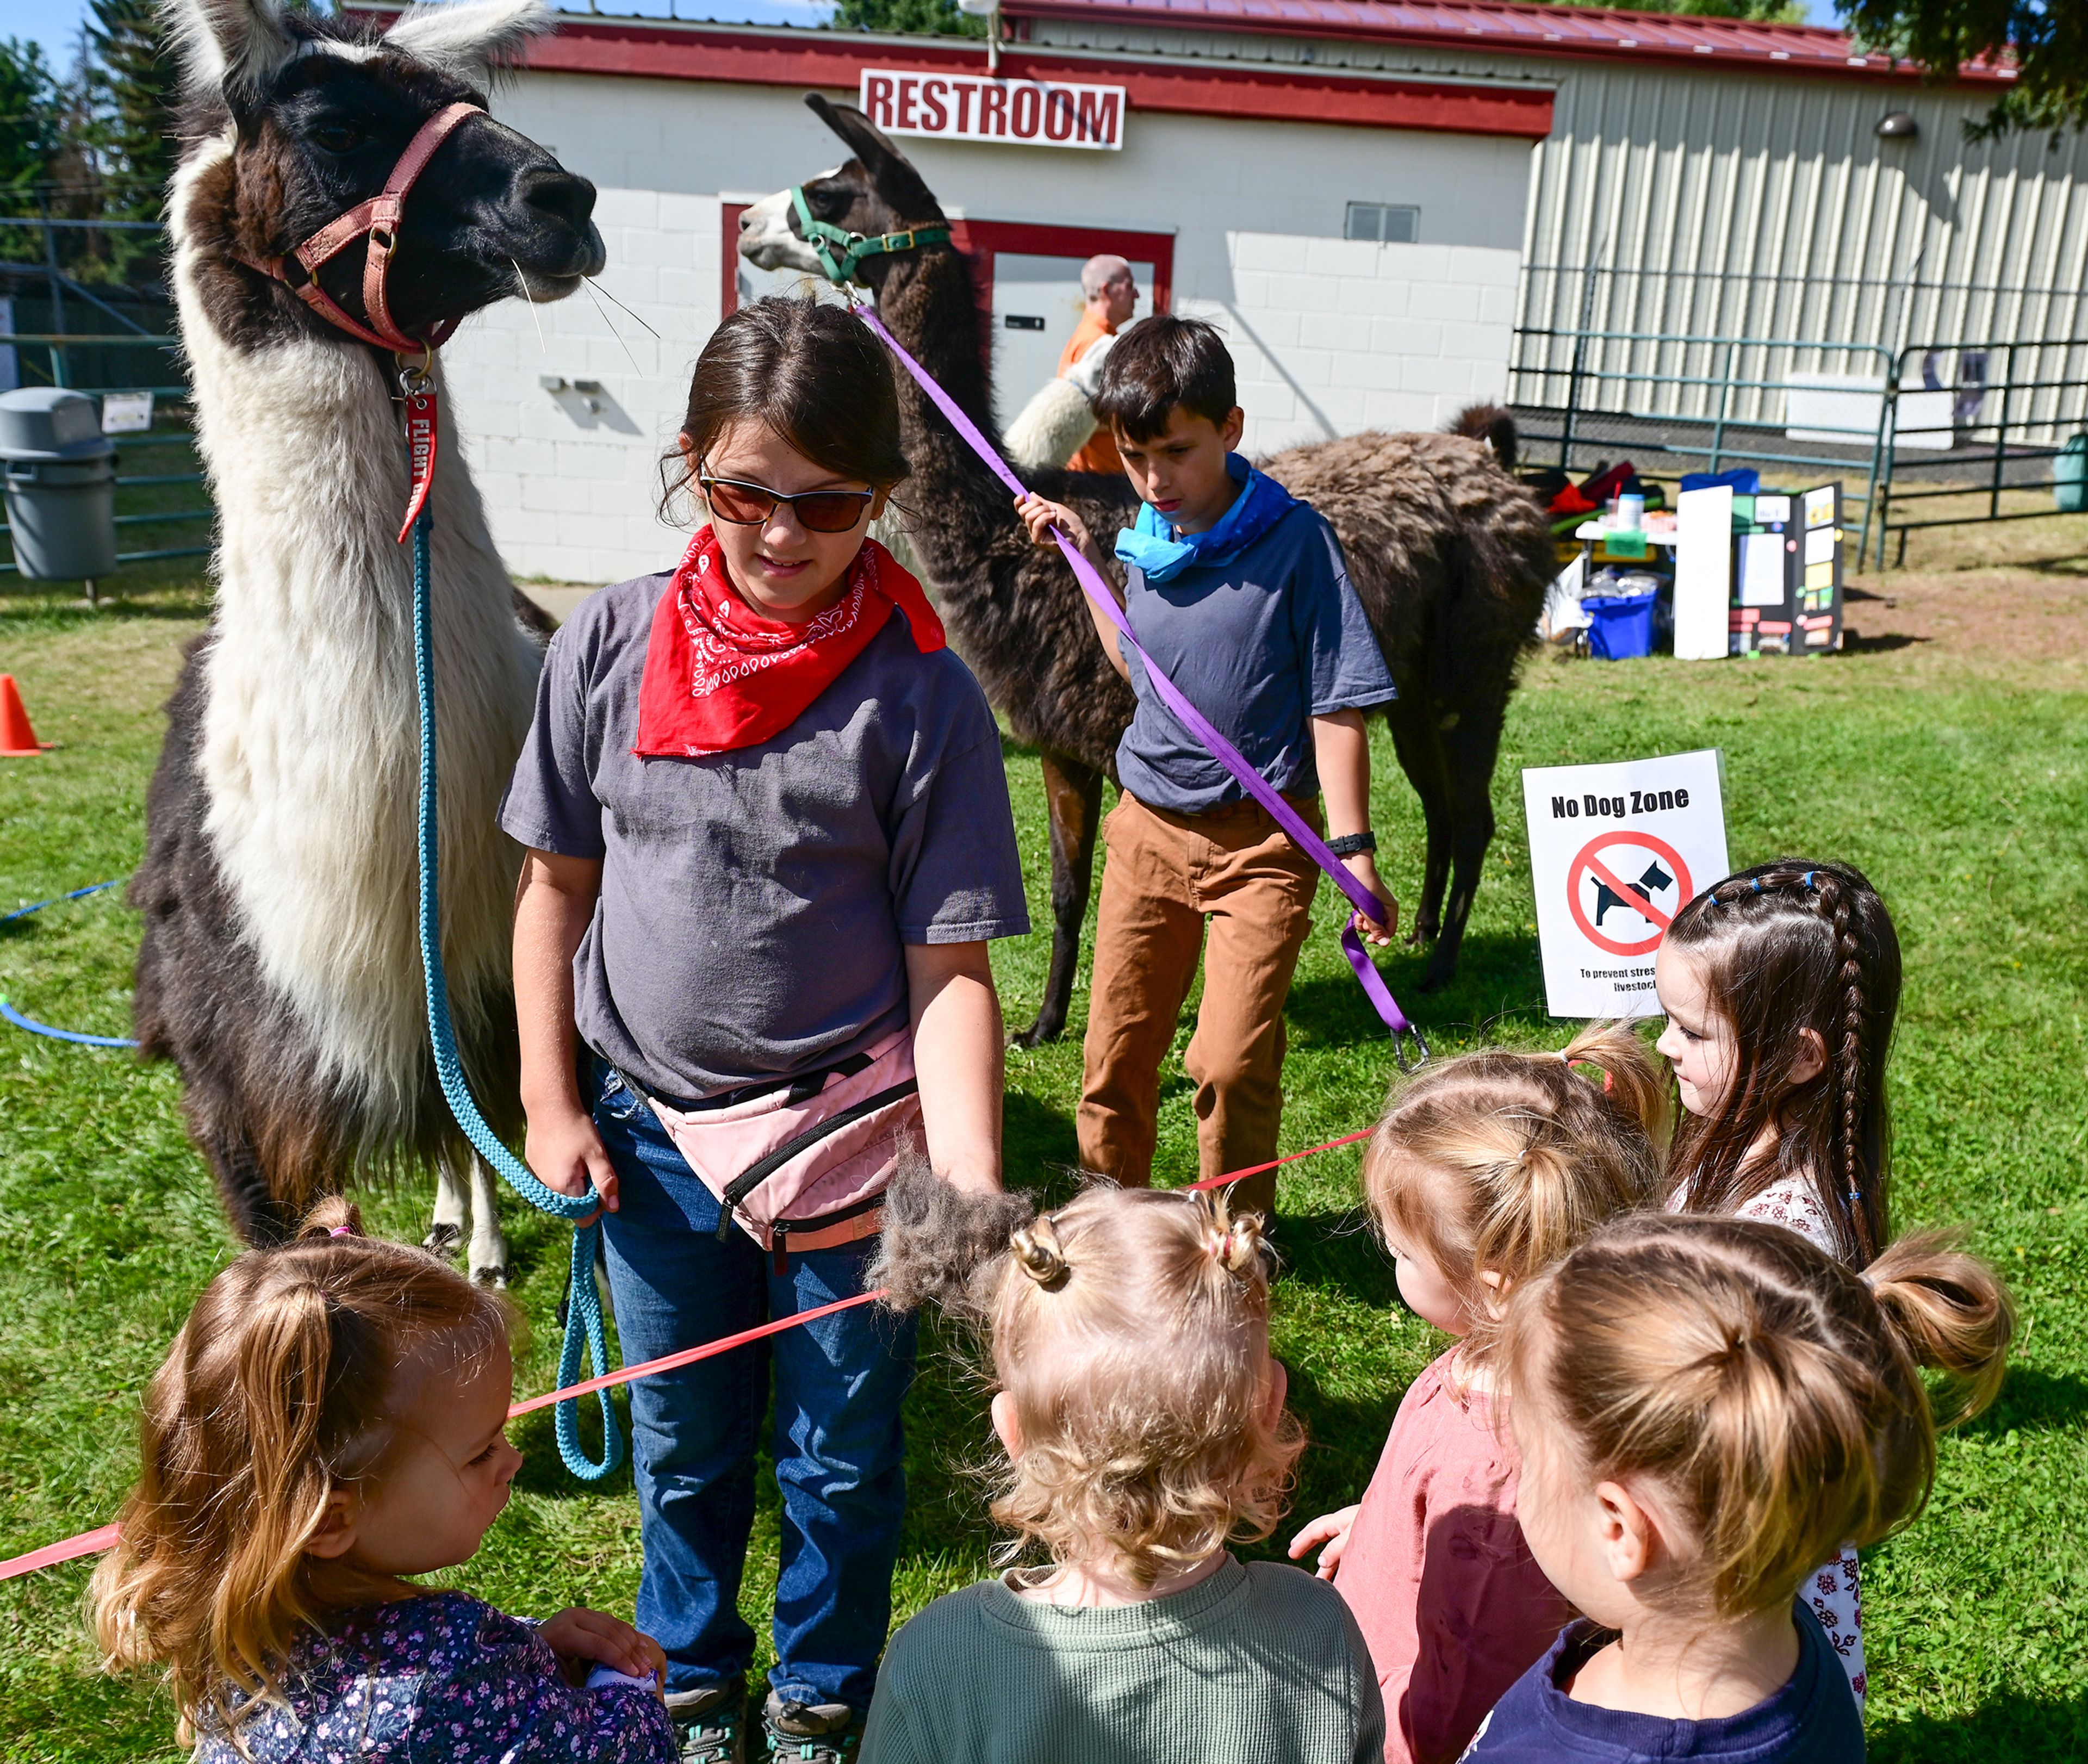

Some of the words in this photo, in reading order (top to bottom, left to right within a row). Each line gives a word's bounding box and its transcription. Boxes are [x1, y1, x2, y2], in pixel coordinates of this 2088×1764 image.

[867, 77, 1118, 144] RESTROOM
[412, 419, 430, 479] FLIGHT
[1551, 797, 1579, 818] No
[1584, 794, 1626, 818] Dog
[1630, 788, 1689, 815] Zone
[1580, 968, 1591, 978] To
[1593, 968, 1629, 979] prevent
